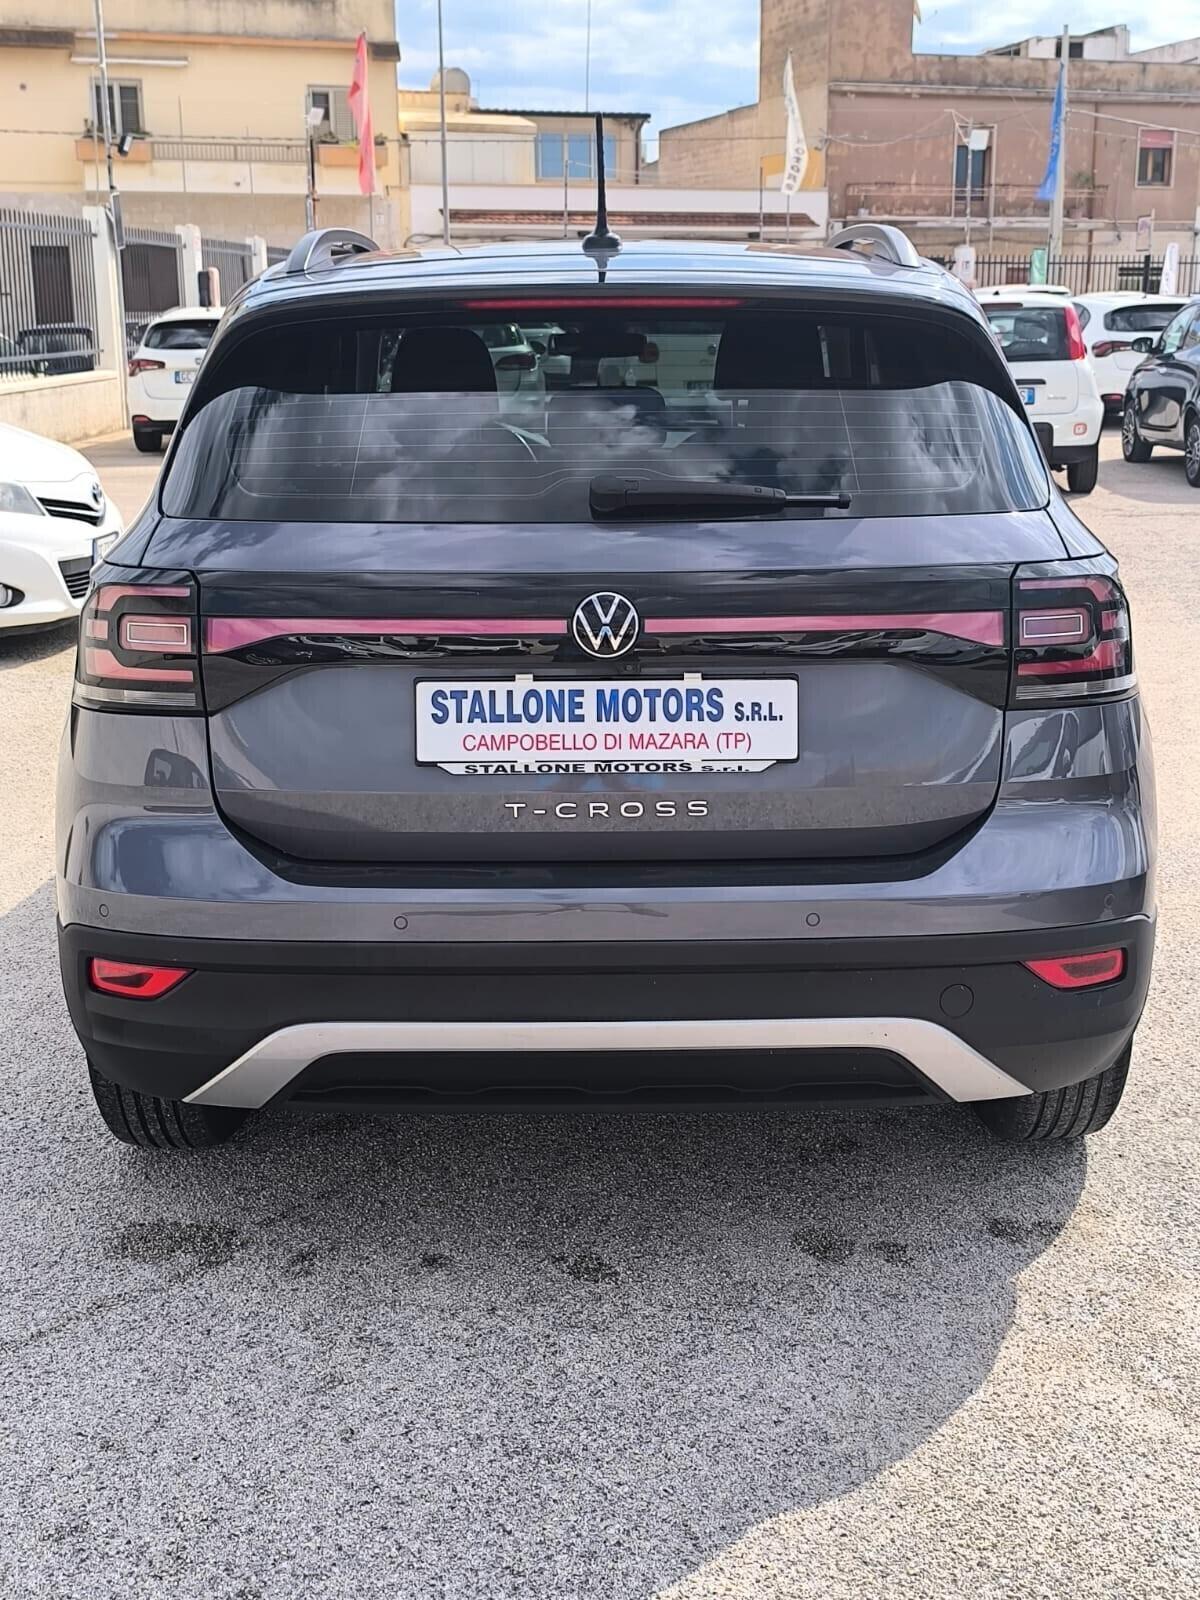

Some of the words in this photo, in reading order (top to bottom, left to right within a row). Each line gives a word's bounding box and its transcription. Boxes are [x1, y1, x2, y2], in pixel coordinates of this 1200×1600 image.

[431, 689, 585, 724] STALLONE
[596, 688, 724, 723] MOTORS
[734, 701, 783, 721] S.R.L.
[462, 733, 597, 752] CAMPOBELLO
[605, 734, 622, 751] DI
[629, 732, 710, 750] MAZARA
[716, 732, 752, 753] (TP)
[464, 763, 586, 774] STALLONE
[594, 762, 693, 773] MOTORS
[504, 800, 710, 818] T-CROSS
